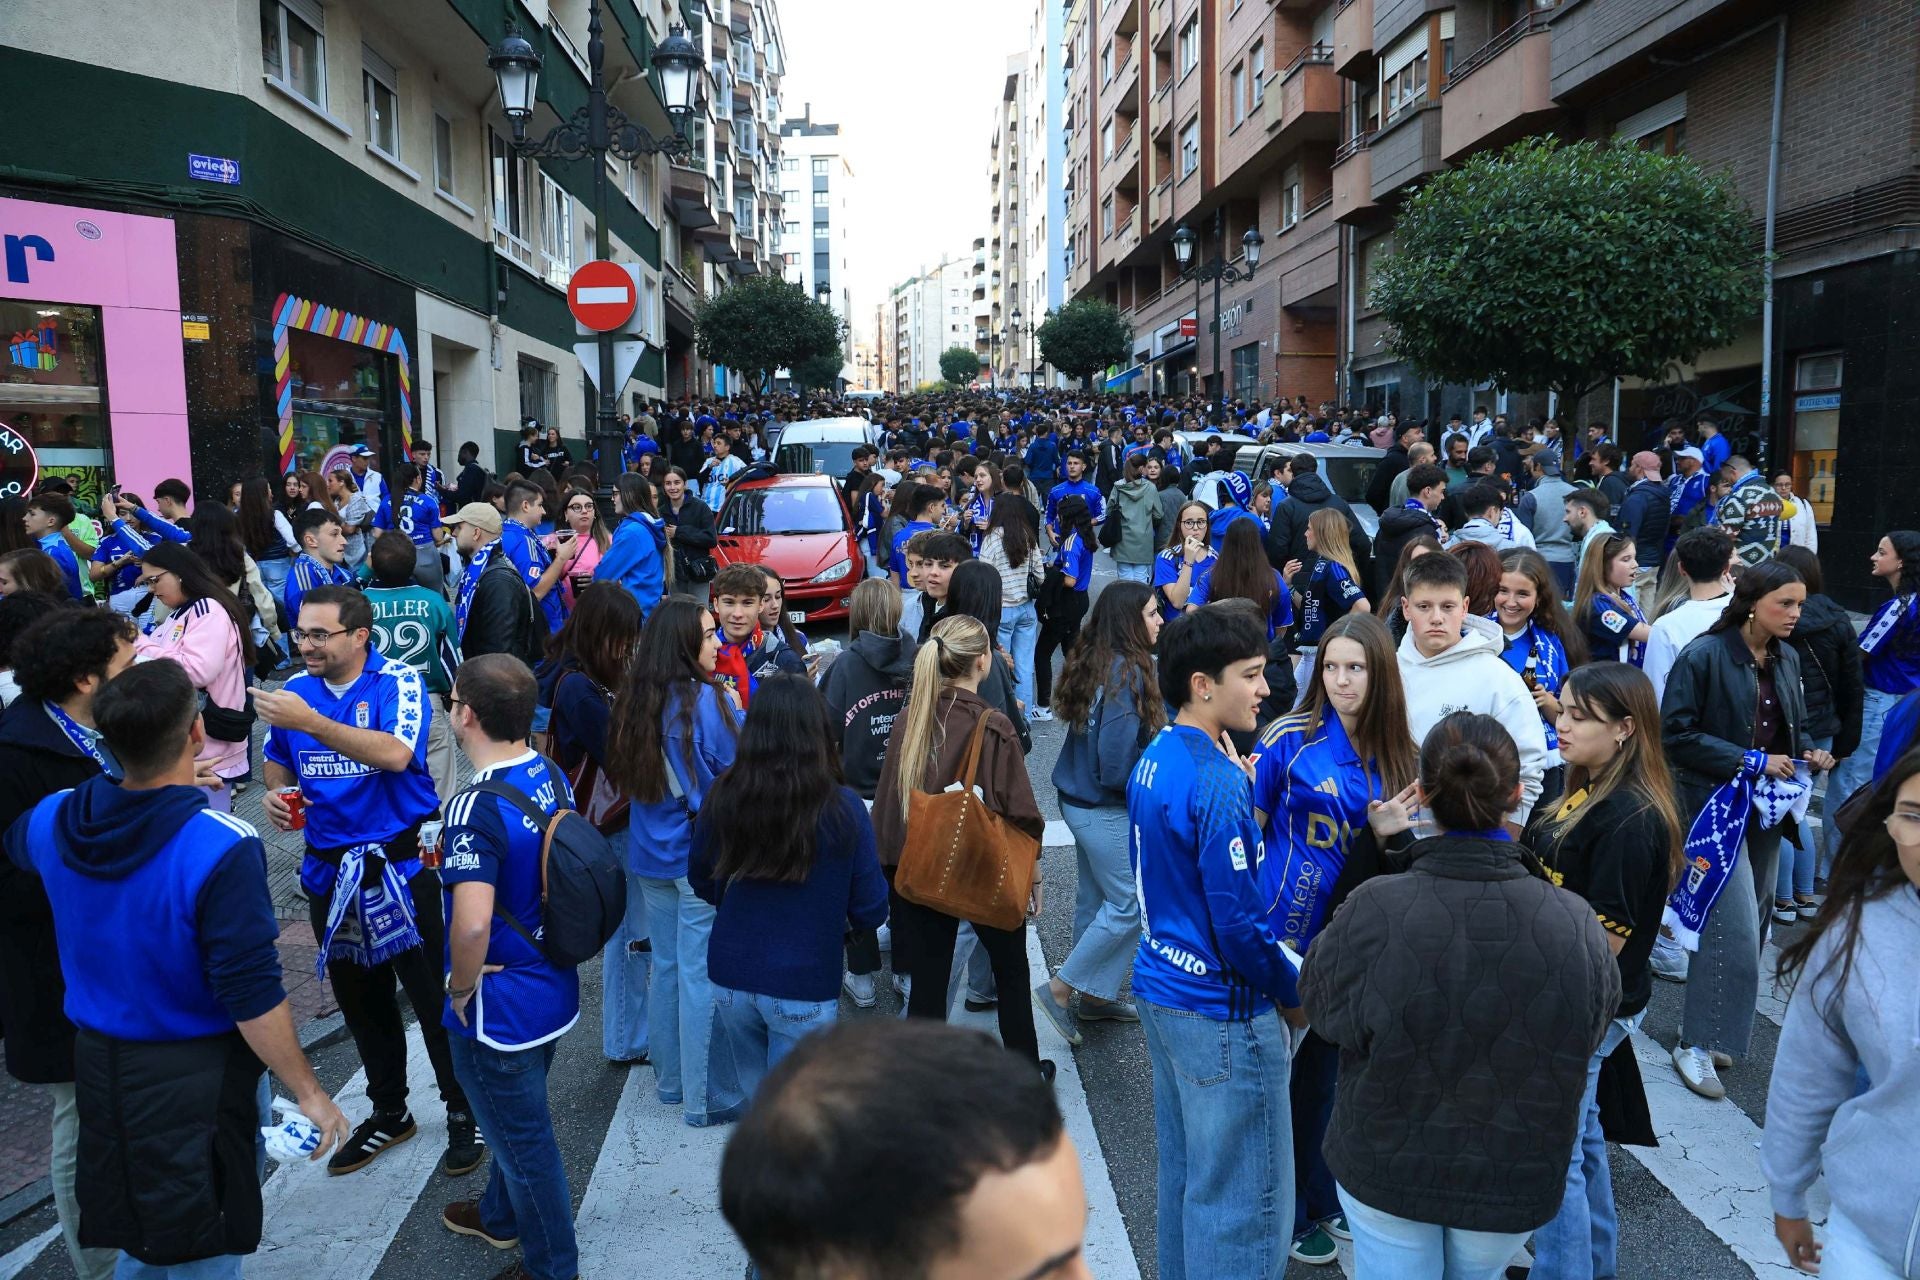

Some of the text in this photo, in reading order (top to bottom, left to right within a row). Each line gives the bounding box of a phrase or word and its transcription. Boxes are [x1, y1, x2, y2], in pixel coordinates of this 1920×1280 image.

[193, 159, 236, 174] oviedo
[4, 233, 55, 284] r
[370, 600, 430, 620] ØLLER
[1304, 590, 1312, 630] OVIEDO
[1311, 599, 1320, 622] Real
[858, 692, 881, 709] OFF
[881, 689, 904, 700] THE
[309, 754, 335, 762] central
[444, 853, 480, 870] INTEGRA
[1284, 861, 1315, 934] OVIEDO
